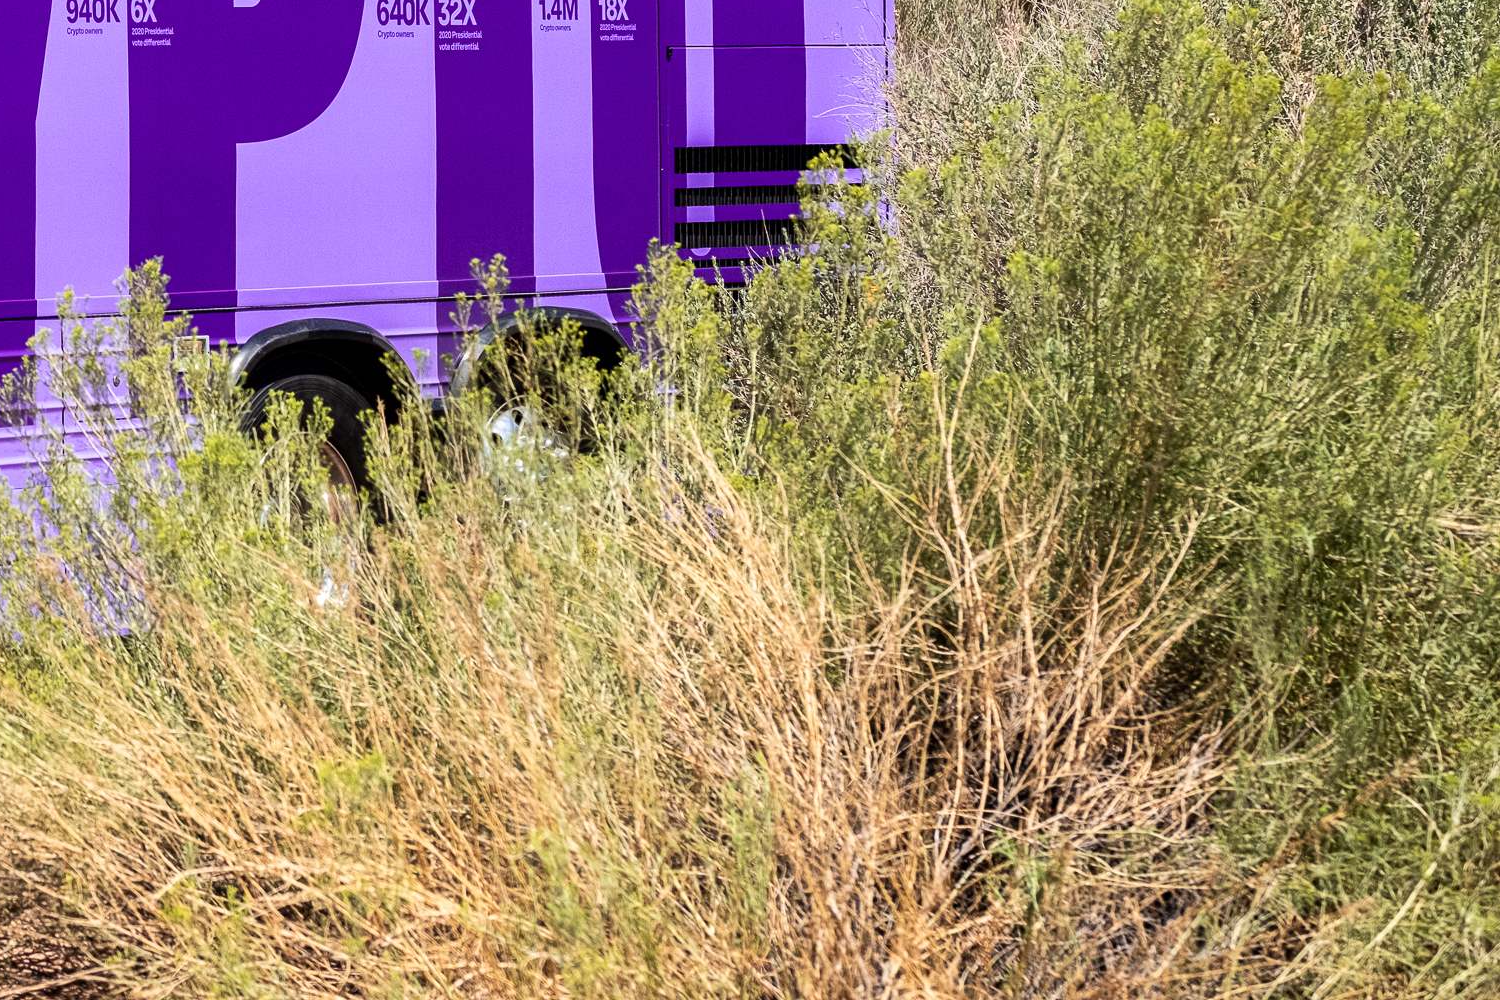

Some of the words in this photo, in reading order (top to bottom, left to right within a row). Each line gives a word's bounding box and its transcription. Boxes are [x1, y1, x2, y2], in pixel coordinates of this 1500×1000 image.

[66, 27, 85, 37] Crypto
[131, 27, 145, 36] 2020
[144, 26, 175, 36] Presidential
[540, 23, 556, 33] Crypto
[377, 29, 396, 40] Crypto
[438, 30, 452, 39] 2020
[451, 30, 483, 39] Presidential
